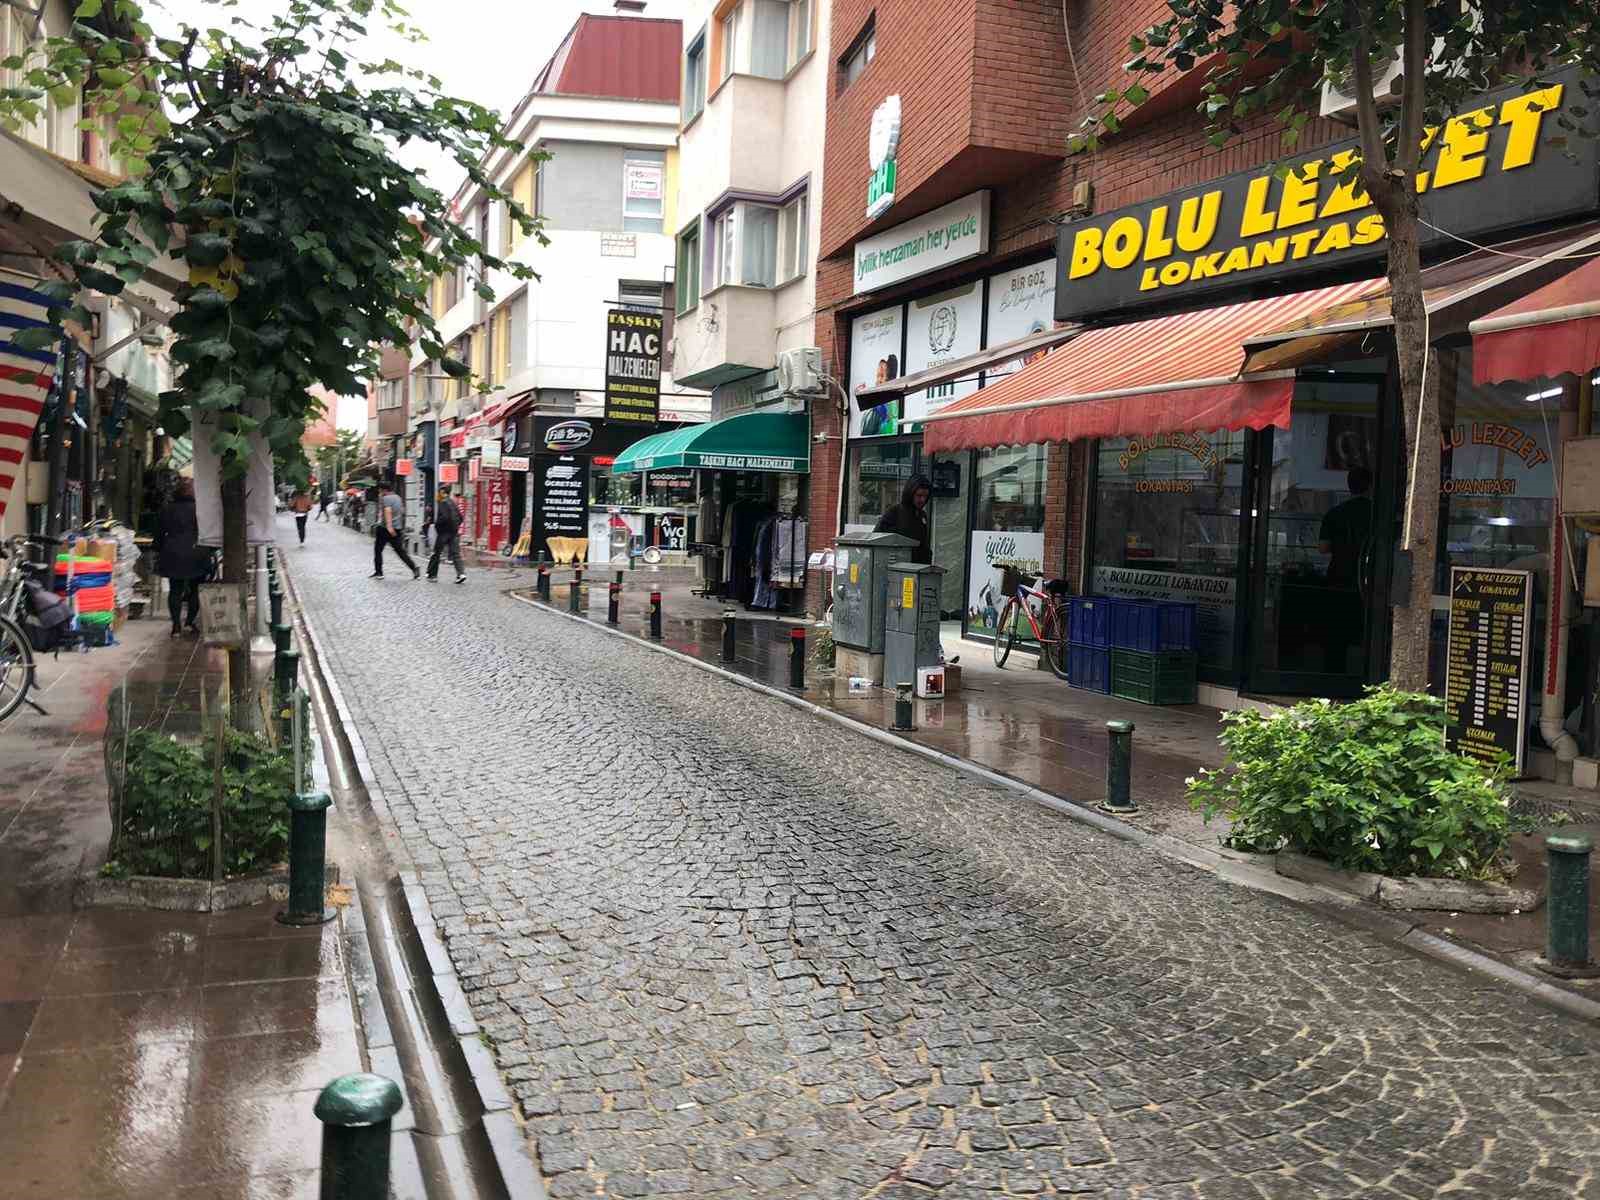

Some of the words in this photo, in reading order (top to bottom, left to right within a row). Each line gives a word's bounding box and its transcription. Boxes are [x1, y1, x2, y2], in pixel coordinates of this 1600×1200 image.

[944, 214, 977, 250] yerde
[1068, 190, 1223, 280] BOLU
[1138, 214, 1388, 291] LOKANTAS
[608, 313, 662, 329] TAŞKIN
[611, 330, 659, 355] HAC
[608, 356, 660, 381] MALZEMELERİ
[1471, 422, 1550, 469] LEZZET
[700, 455, 726, 468] TAŞKIN
[1135, 480, 1193, 496] LOKANTASI
[1110, 570, 1135, 584] BOLU
[1135, 574, 1171, 588] LEZZET
